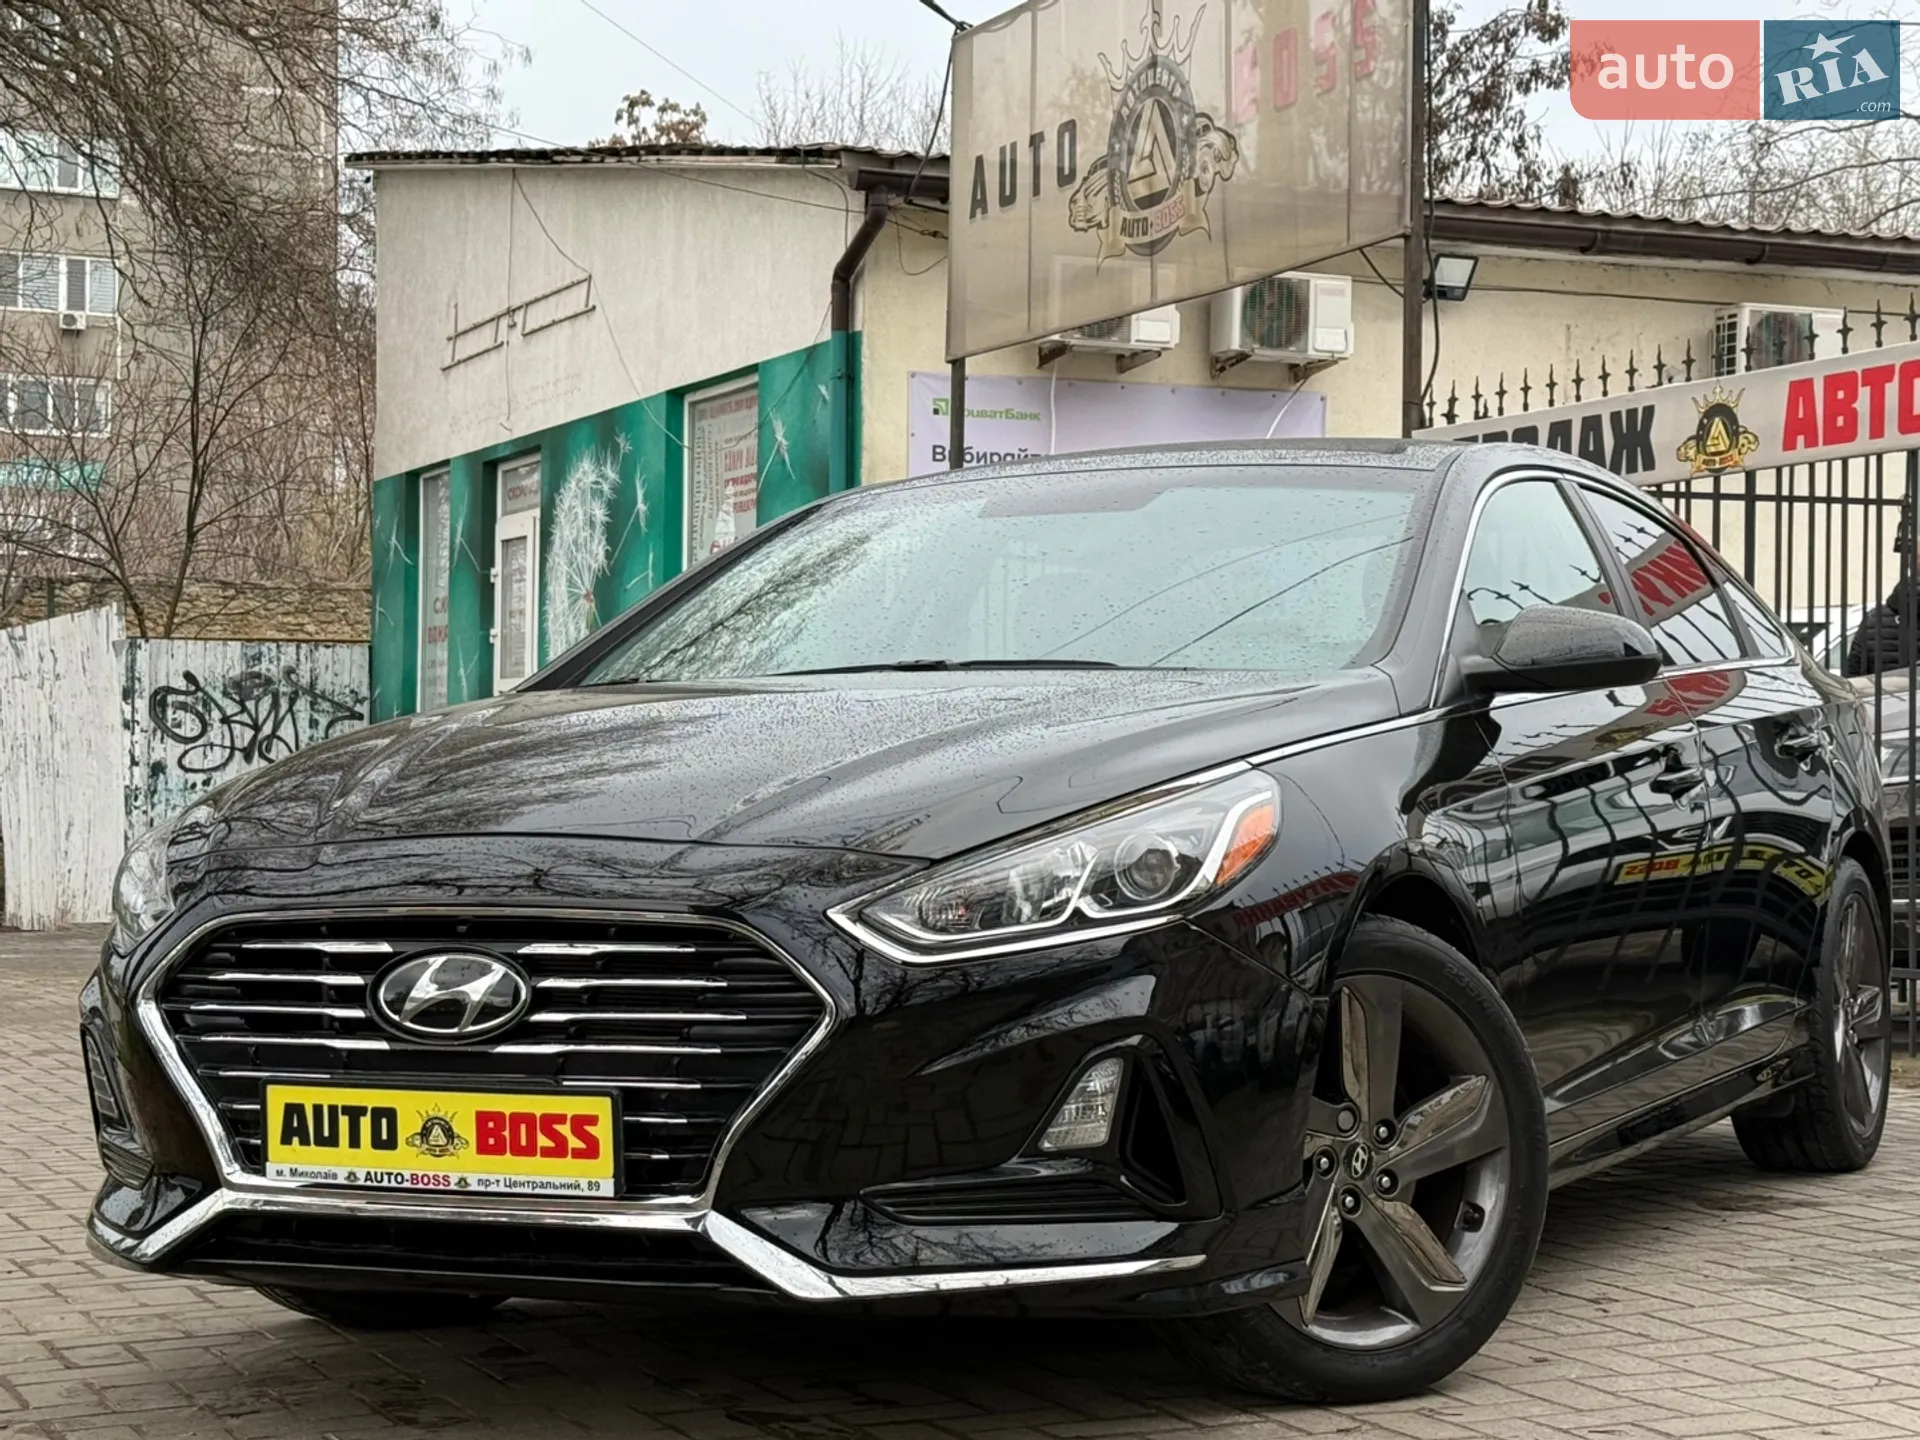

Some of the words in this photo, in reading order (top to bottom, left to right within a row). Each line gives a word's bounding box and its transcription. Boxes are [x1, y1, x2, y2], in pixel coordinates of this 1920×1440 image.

[968, 118, 1077, 220] AUTO
[1233, 0, 1377, 126] BOSS
[965, 407, 1042, 422] иватБанк
[279, 1102, 399, 1151] AUTO
[474, 1110, 601, 1160] BOSS
[289, 1167, 339, 1181] Миколаїв
[363, 1171, 452, 1188] AUTO-BOSS
[477, 1178, 501, 1189] пр-т
[504, 1177, 585, 1192] Центральний,
[587, 1180, 601, 1192] 89
